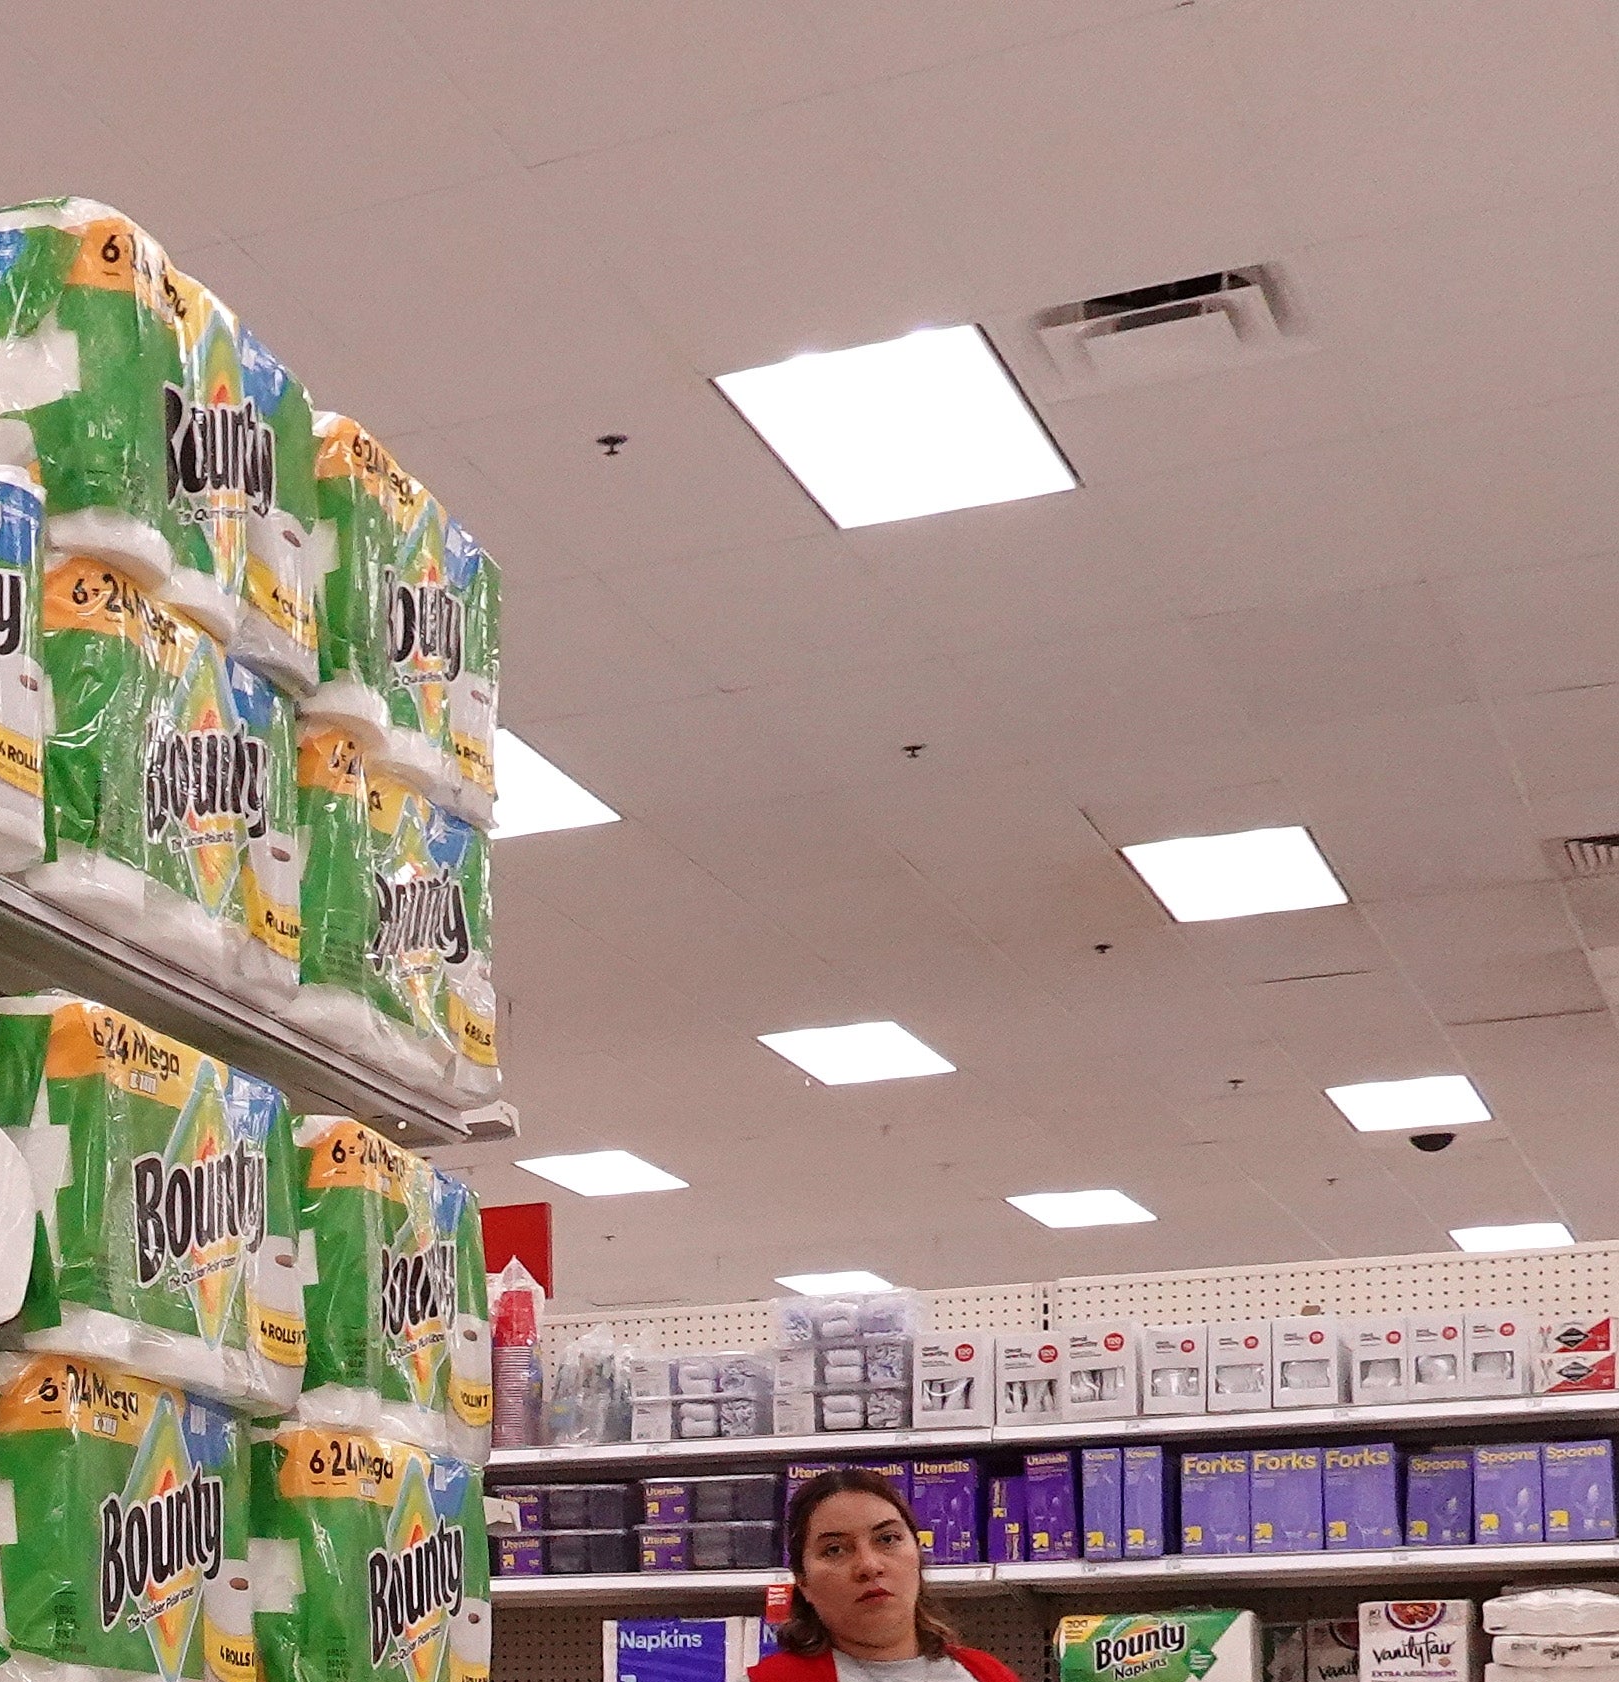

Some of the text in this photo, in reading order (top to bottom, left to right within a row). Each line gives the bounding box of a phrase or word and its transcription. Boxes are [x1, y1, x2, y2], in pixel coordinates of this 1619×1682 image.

[131, 1037, 180, 1079] Mega
[136, 1147, 265, 1284] Bounty
[912, 1460, 971, 1477] Utensils
[1183, 1456, 1246, 1475] Forks
[1252, 1452, 1317, 1472] Forks
[1324, 1449, 1390, 1468] Forks
[102, 1466, 223, 1628] Bounty
[371, 1519, 464, 1664] Bounty
[620, 1632, 702, 1651] Napkins
[1095, 1621, 1186, 1673] Bounty
[1114, 1657, 1168, 1681] Napkins
